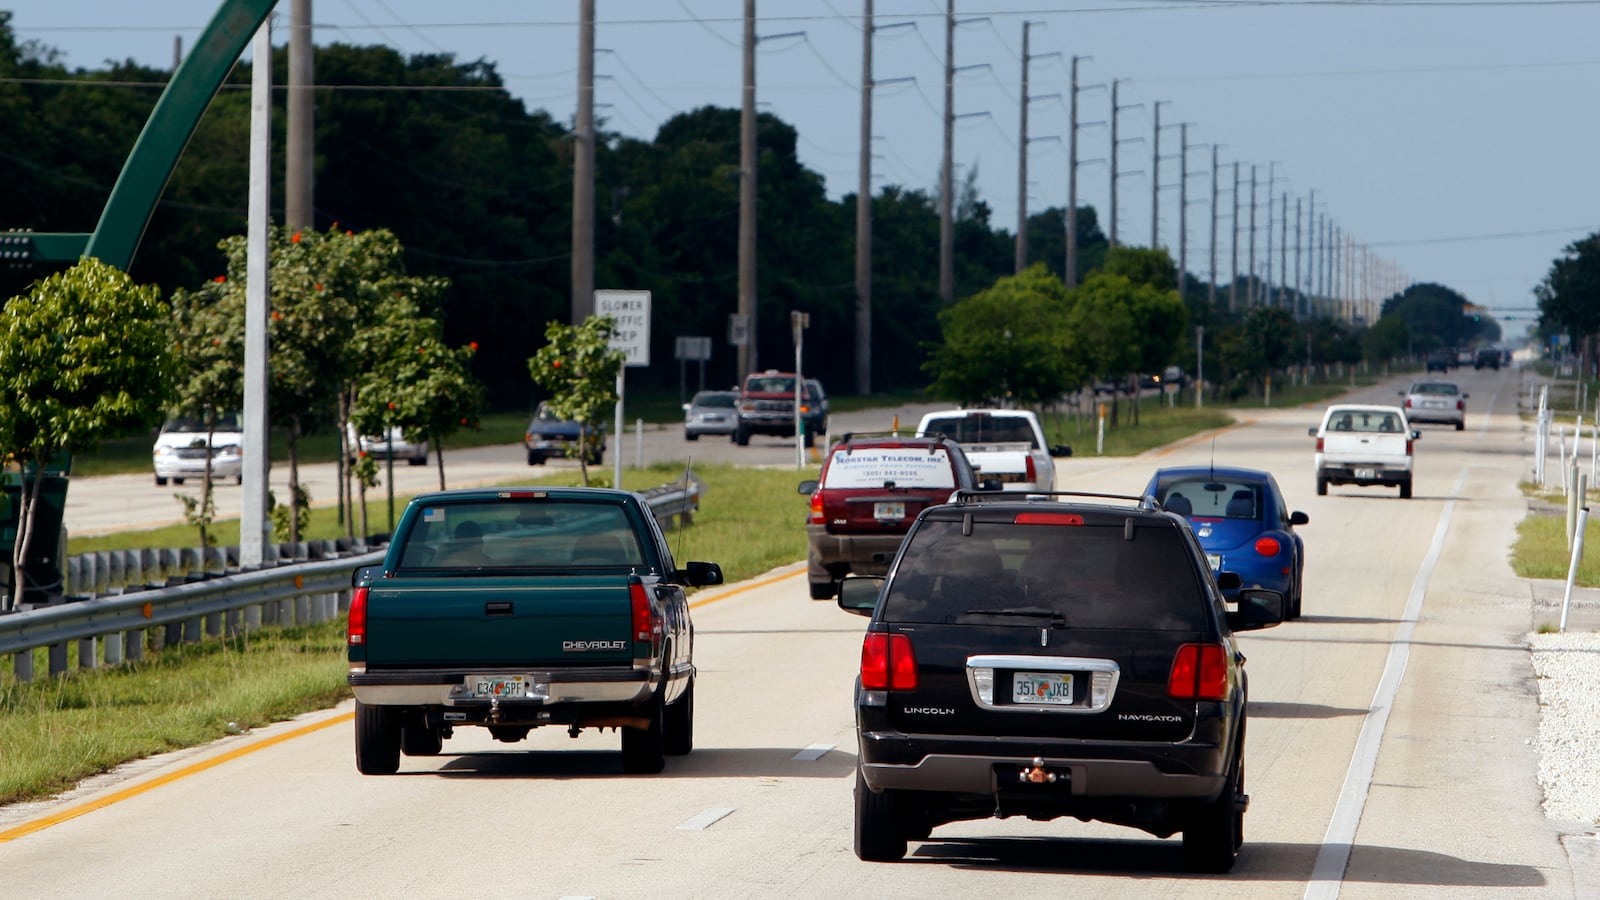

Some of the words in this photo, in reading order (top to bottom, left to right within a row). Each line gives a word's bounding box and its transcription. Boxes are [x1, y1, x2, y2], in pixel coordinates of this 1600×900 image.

[602, 300, 642, 311] SLOWER
[562, 640, 627, 650] CHEVROLET
[477, 682, 494, 695] C34
[505, 682, 522, 695] 5PF
[1016, 681, 1036, 696] 351
[1049, 682, 1069, 697] JXB
[903, 707, 955, 715] LINCOLN
[1118, 714, 1182, 722] NAVIGATOR
